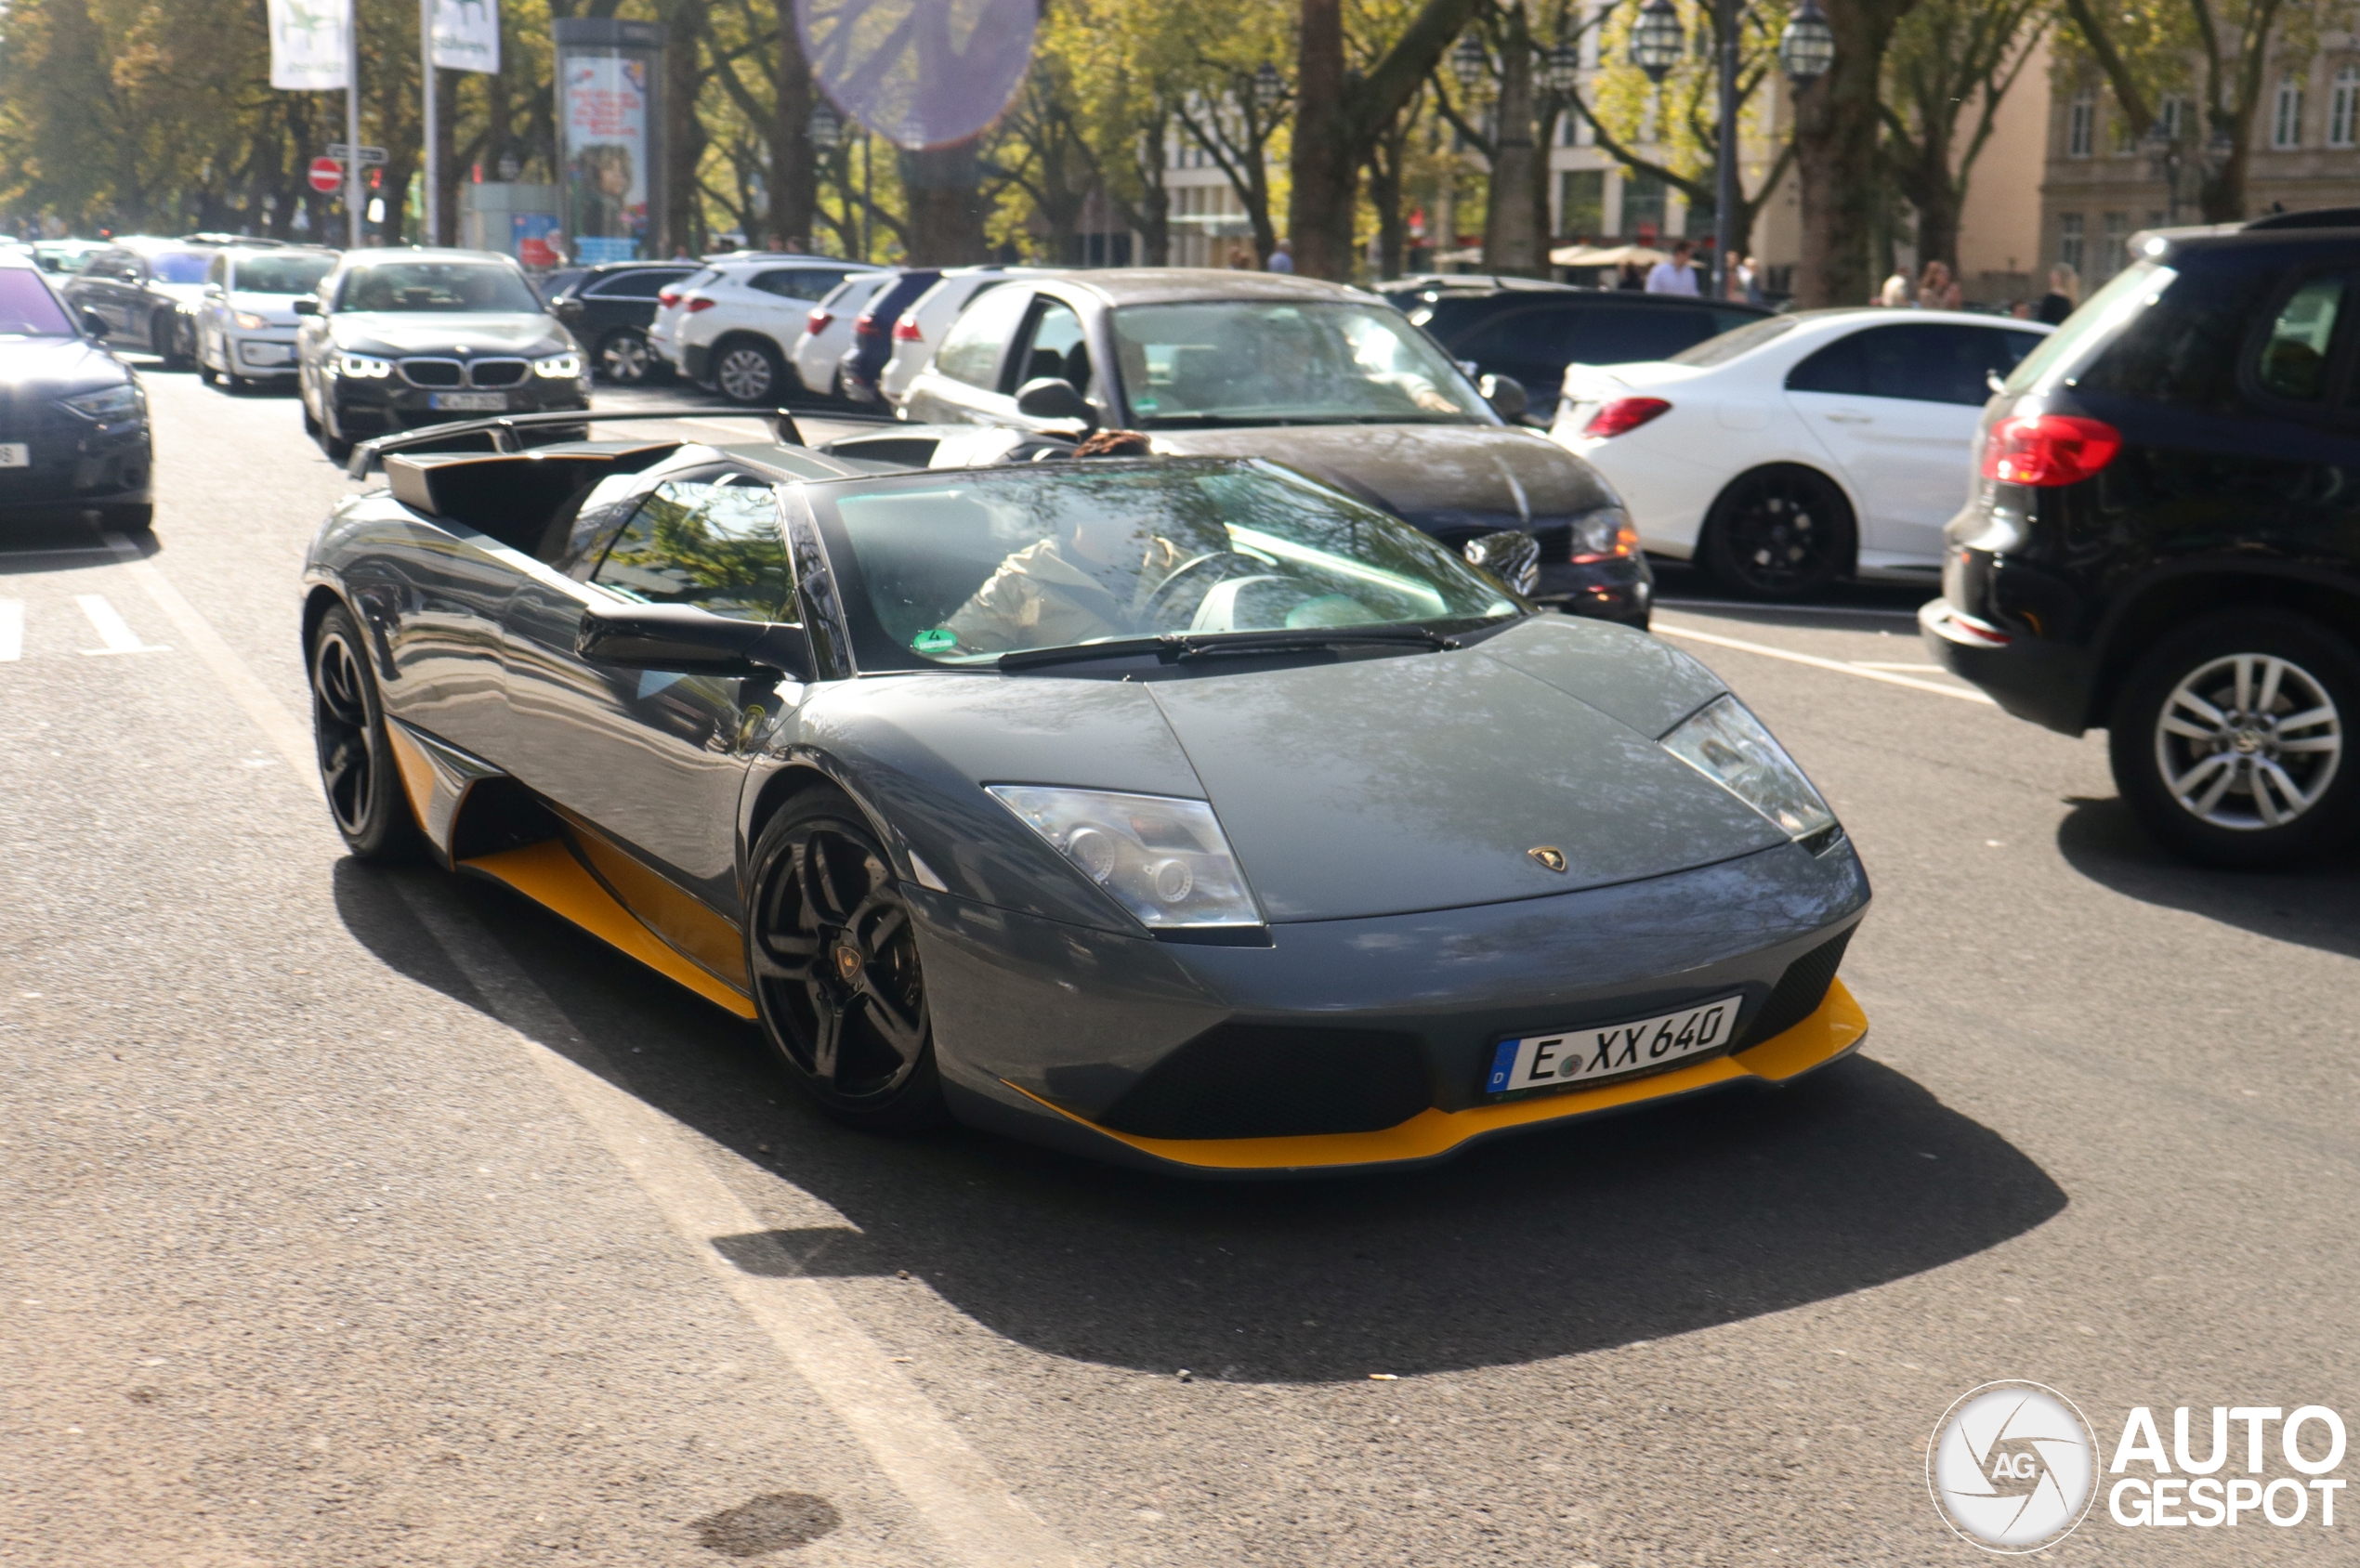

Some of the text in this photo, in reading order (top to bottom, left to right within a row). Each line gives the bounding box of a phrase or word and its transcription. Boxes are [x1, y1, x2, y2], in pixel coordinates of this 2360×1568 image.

[928, 631, 941, 640] 4
[1493, 1072, 1504, 1084] D
[1528, 1039, 1563, 1080] E
[1586, 1025, 1647, 1072] XX
[1650, 1006, 1724, 1058] 640
